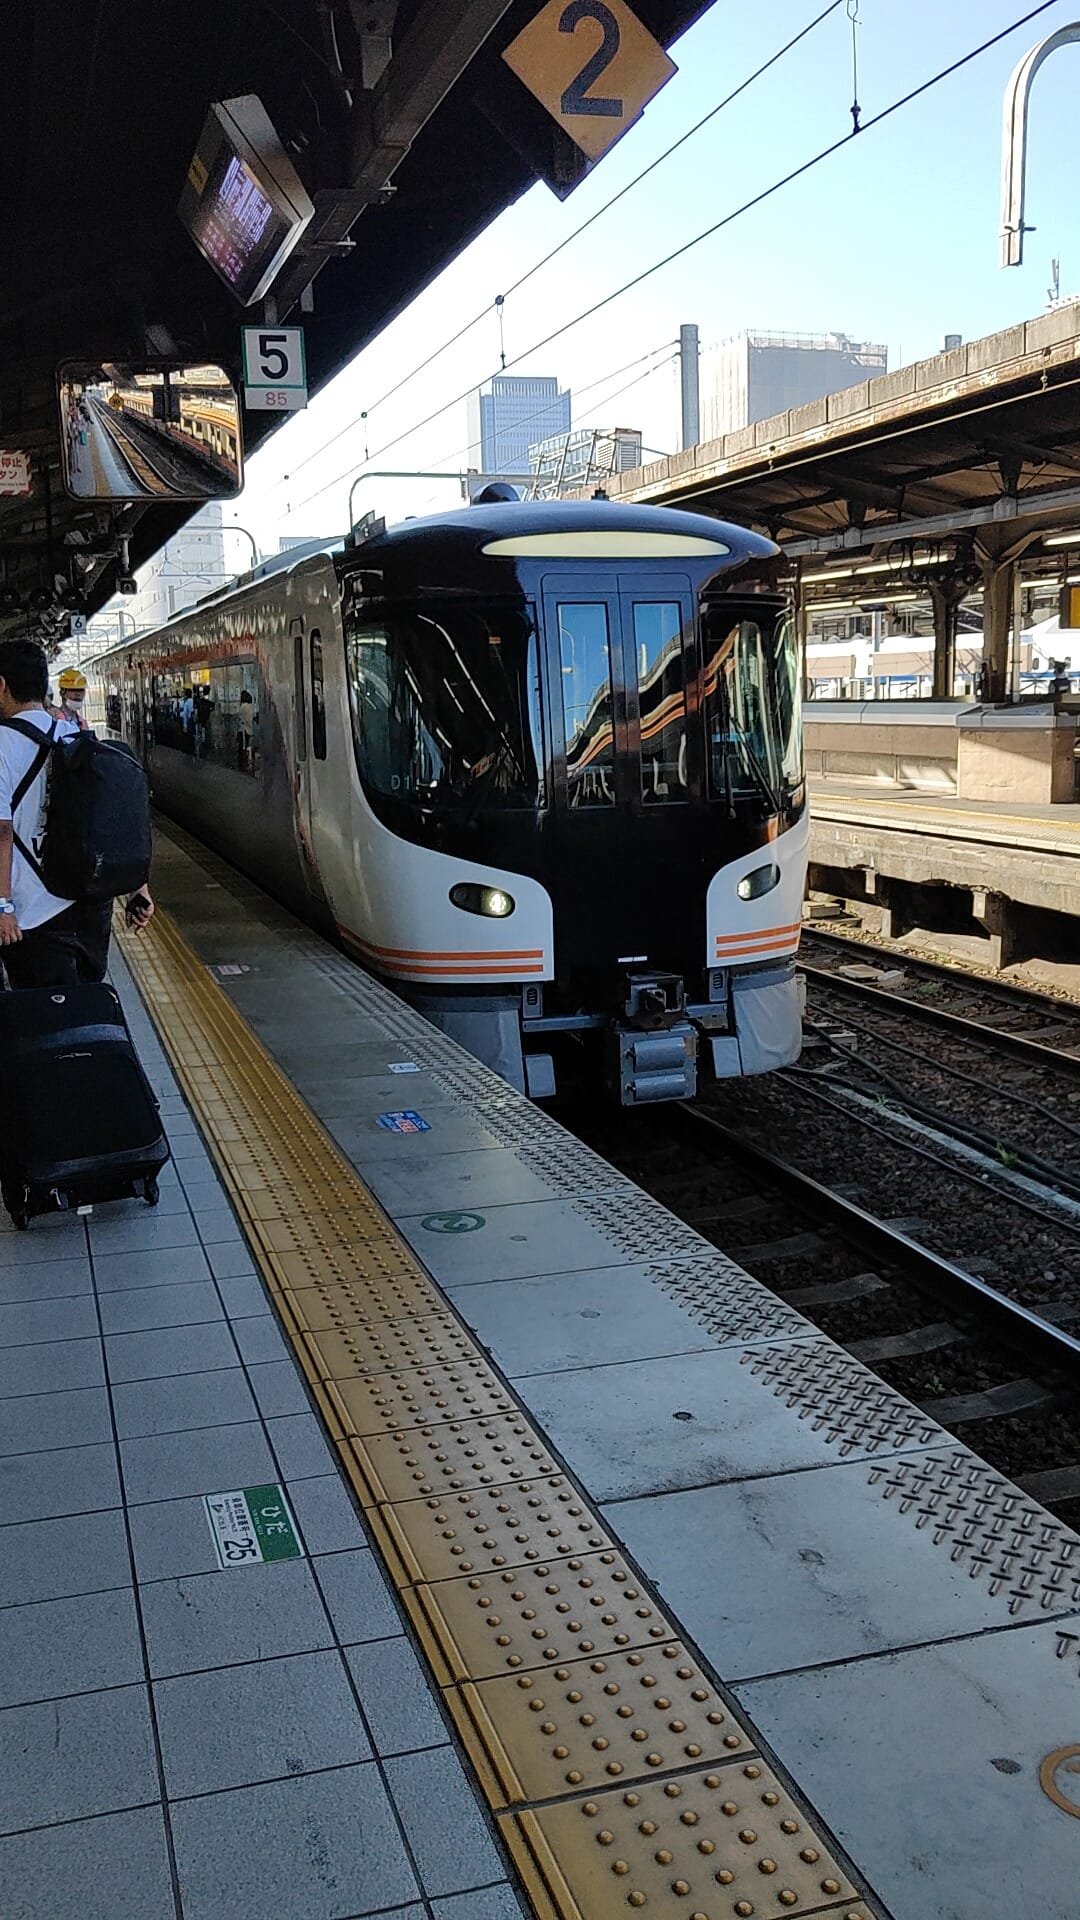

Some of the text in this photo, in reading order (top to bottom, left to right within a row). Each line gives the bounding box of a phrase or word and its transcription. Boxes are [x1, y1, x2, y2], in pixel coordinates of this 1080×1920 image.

[558, 0, 623, 117] 2
[259, 335, 288, 379] 5
[265, 391, 288, 406] 85
[75, 617, 83, 629] 6
[261, 1505, 289, 1536] ひだ
[223, 1538, 257, 1560] 25
